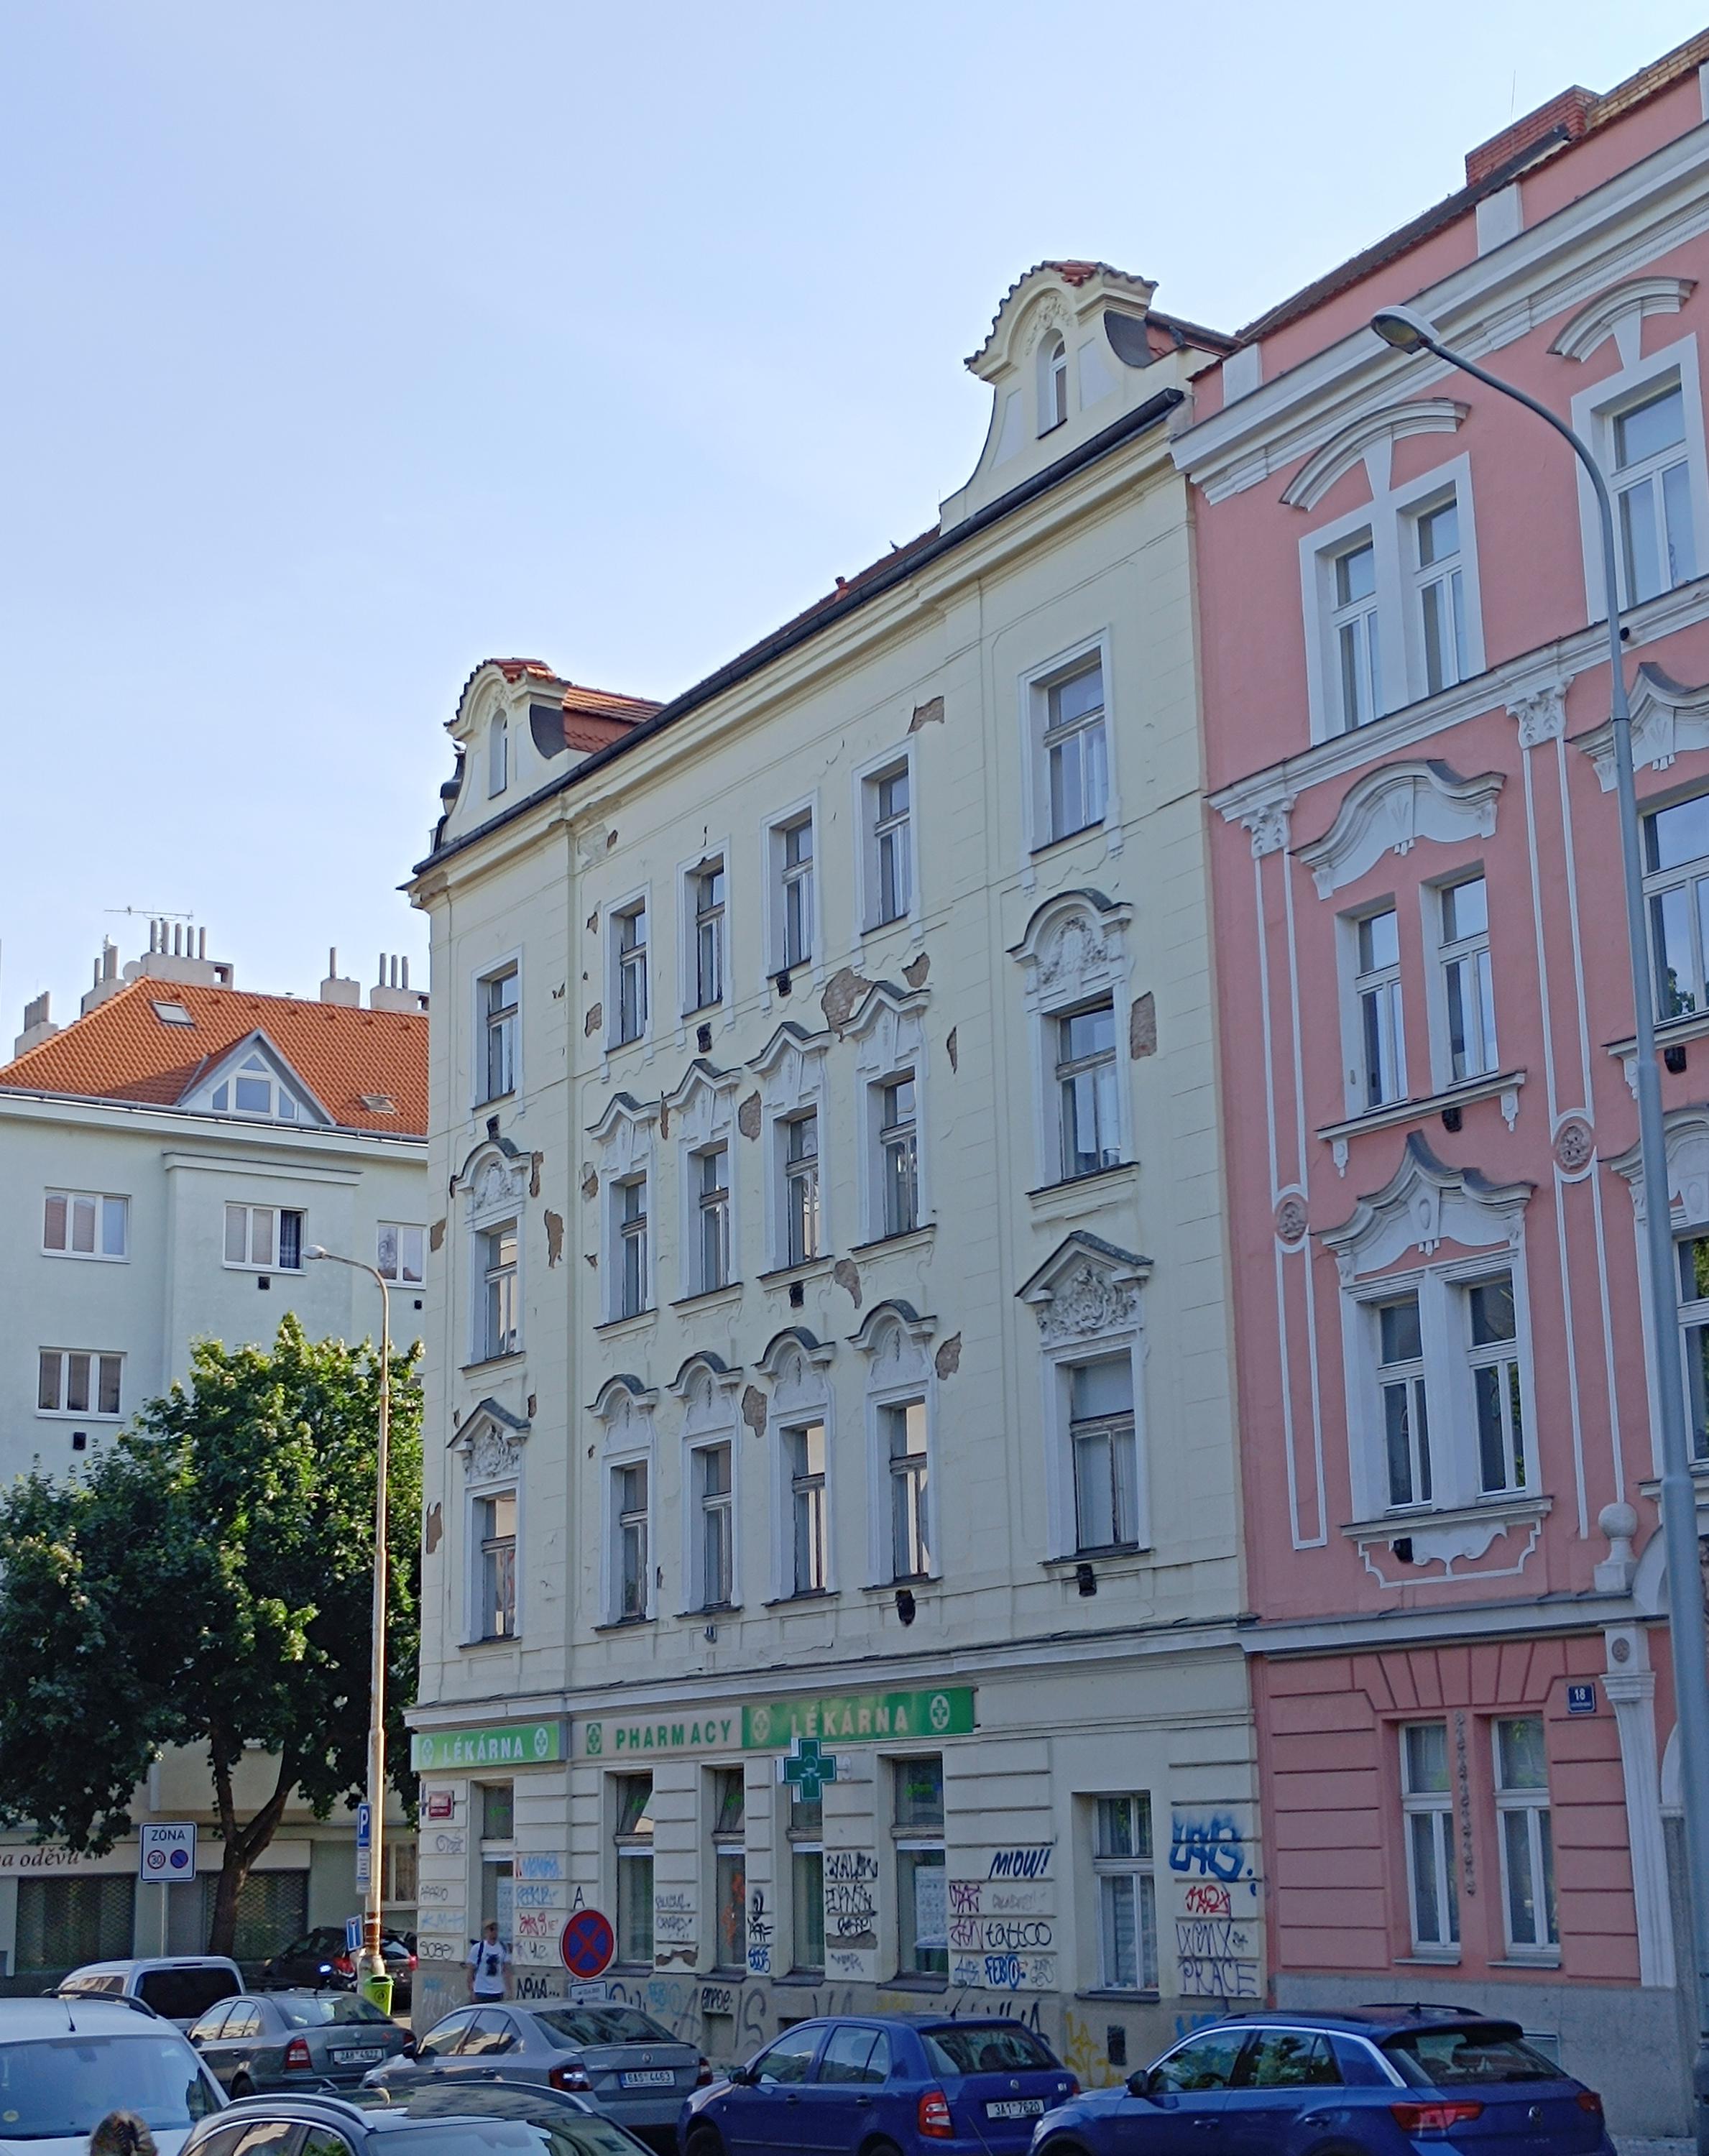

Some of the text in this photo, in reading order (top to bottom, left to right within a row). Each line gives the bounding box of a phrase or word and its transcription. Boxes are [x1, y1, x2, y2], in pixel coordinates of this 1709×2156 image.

[1575, 1687, 1586, 1701] 18
[616, 1719, 732, 1750] PHARMACY
[791, 1703, 909, 1738] LÉKÁRNA
[443, 1733, 524, 1764] LÉKÁRNA
[360, 1809, 369, 1835] P
